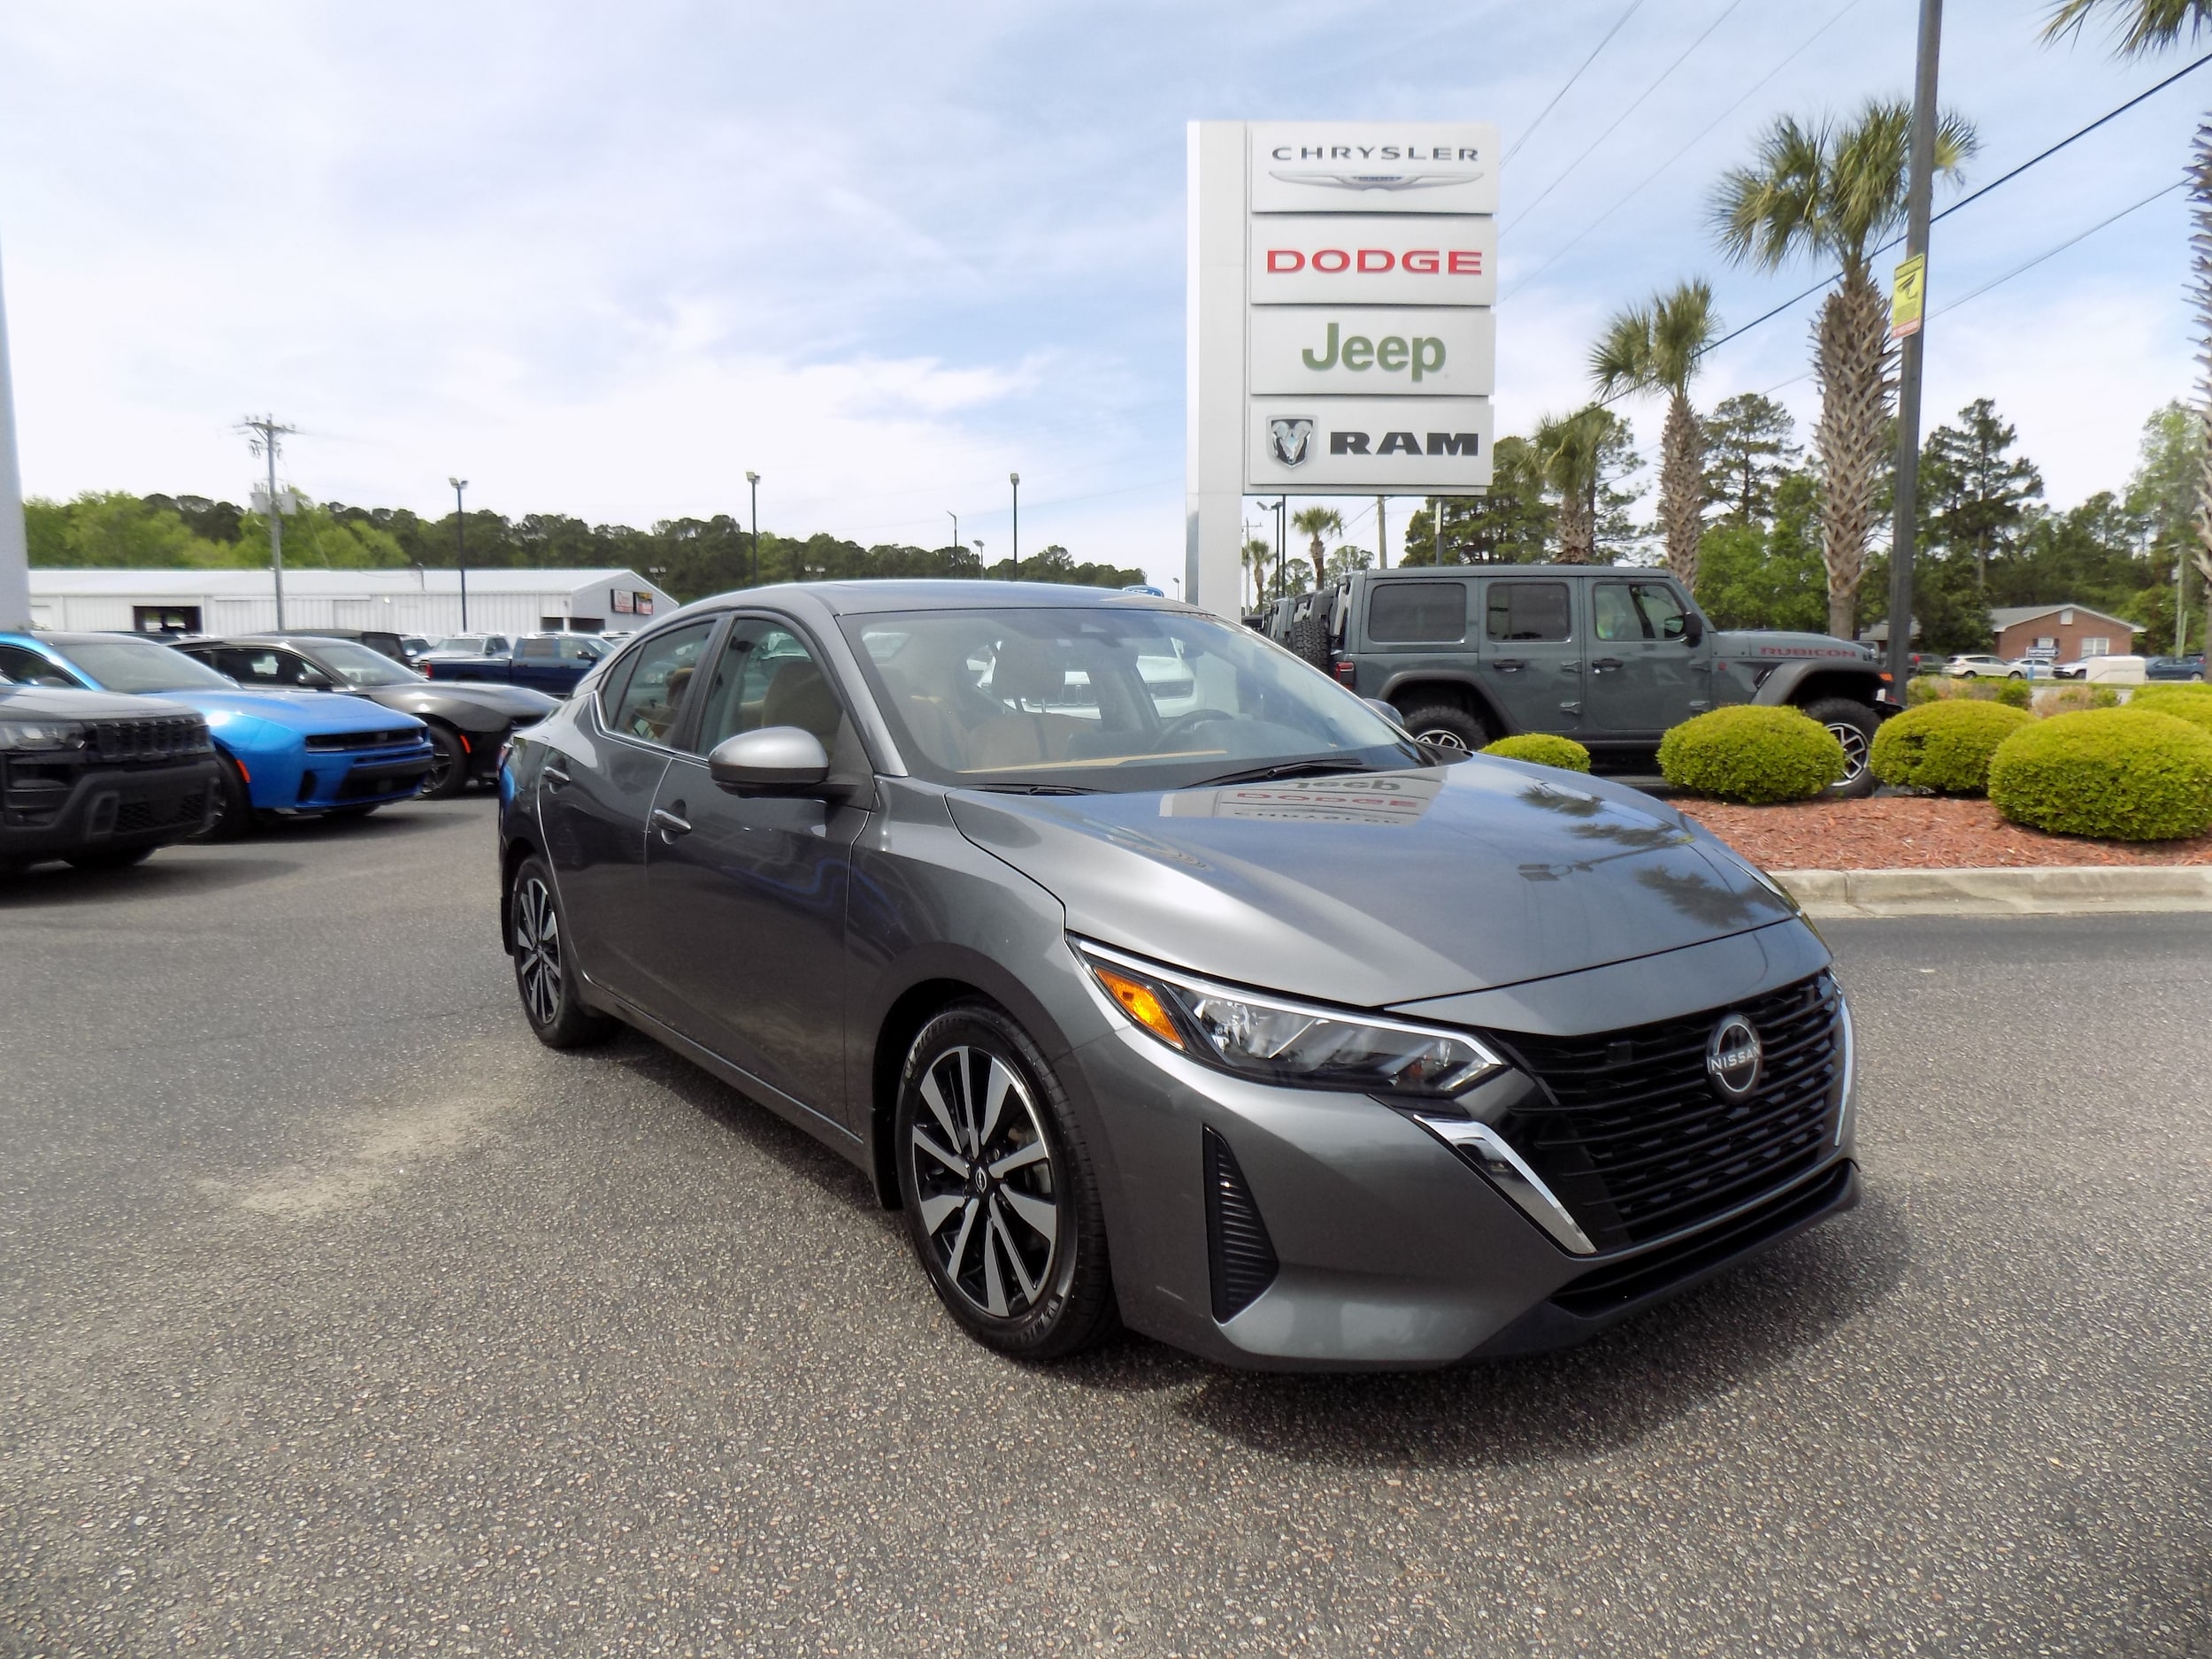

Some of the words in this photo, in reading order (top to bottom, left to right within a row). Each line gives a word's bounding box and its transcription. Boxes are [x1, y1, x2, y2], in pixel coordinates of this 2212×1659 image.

[1271, 146, 1479, 162] CHRYSLER
[1267, 249, 1483, 276] DODGE
[1302, 322, 1447, 382] Jeep
[1330, 431, 1479, 457] RAM
[1760, 646, 1856, 658] RUBICON
[1710, 1046, 1760, 1071] NISSAN
